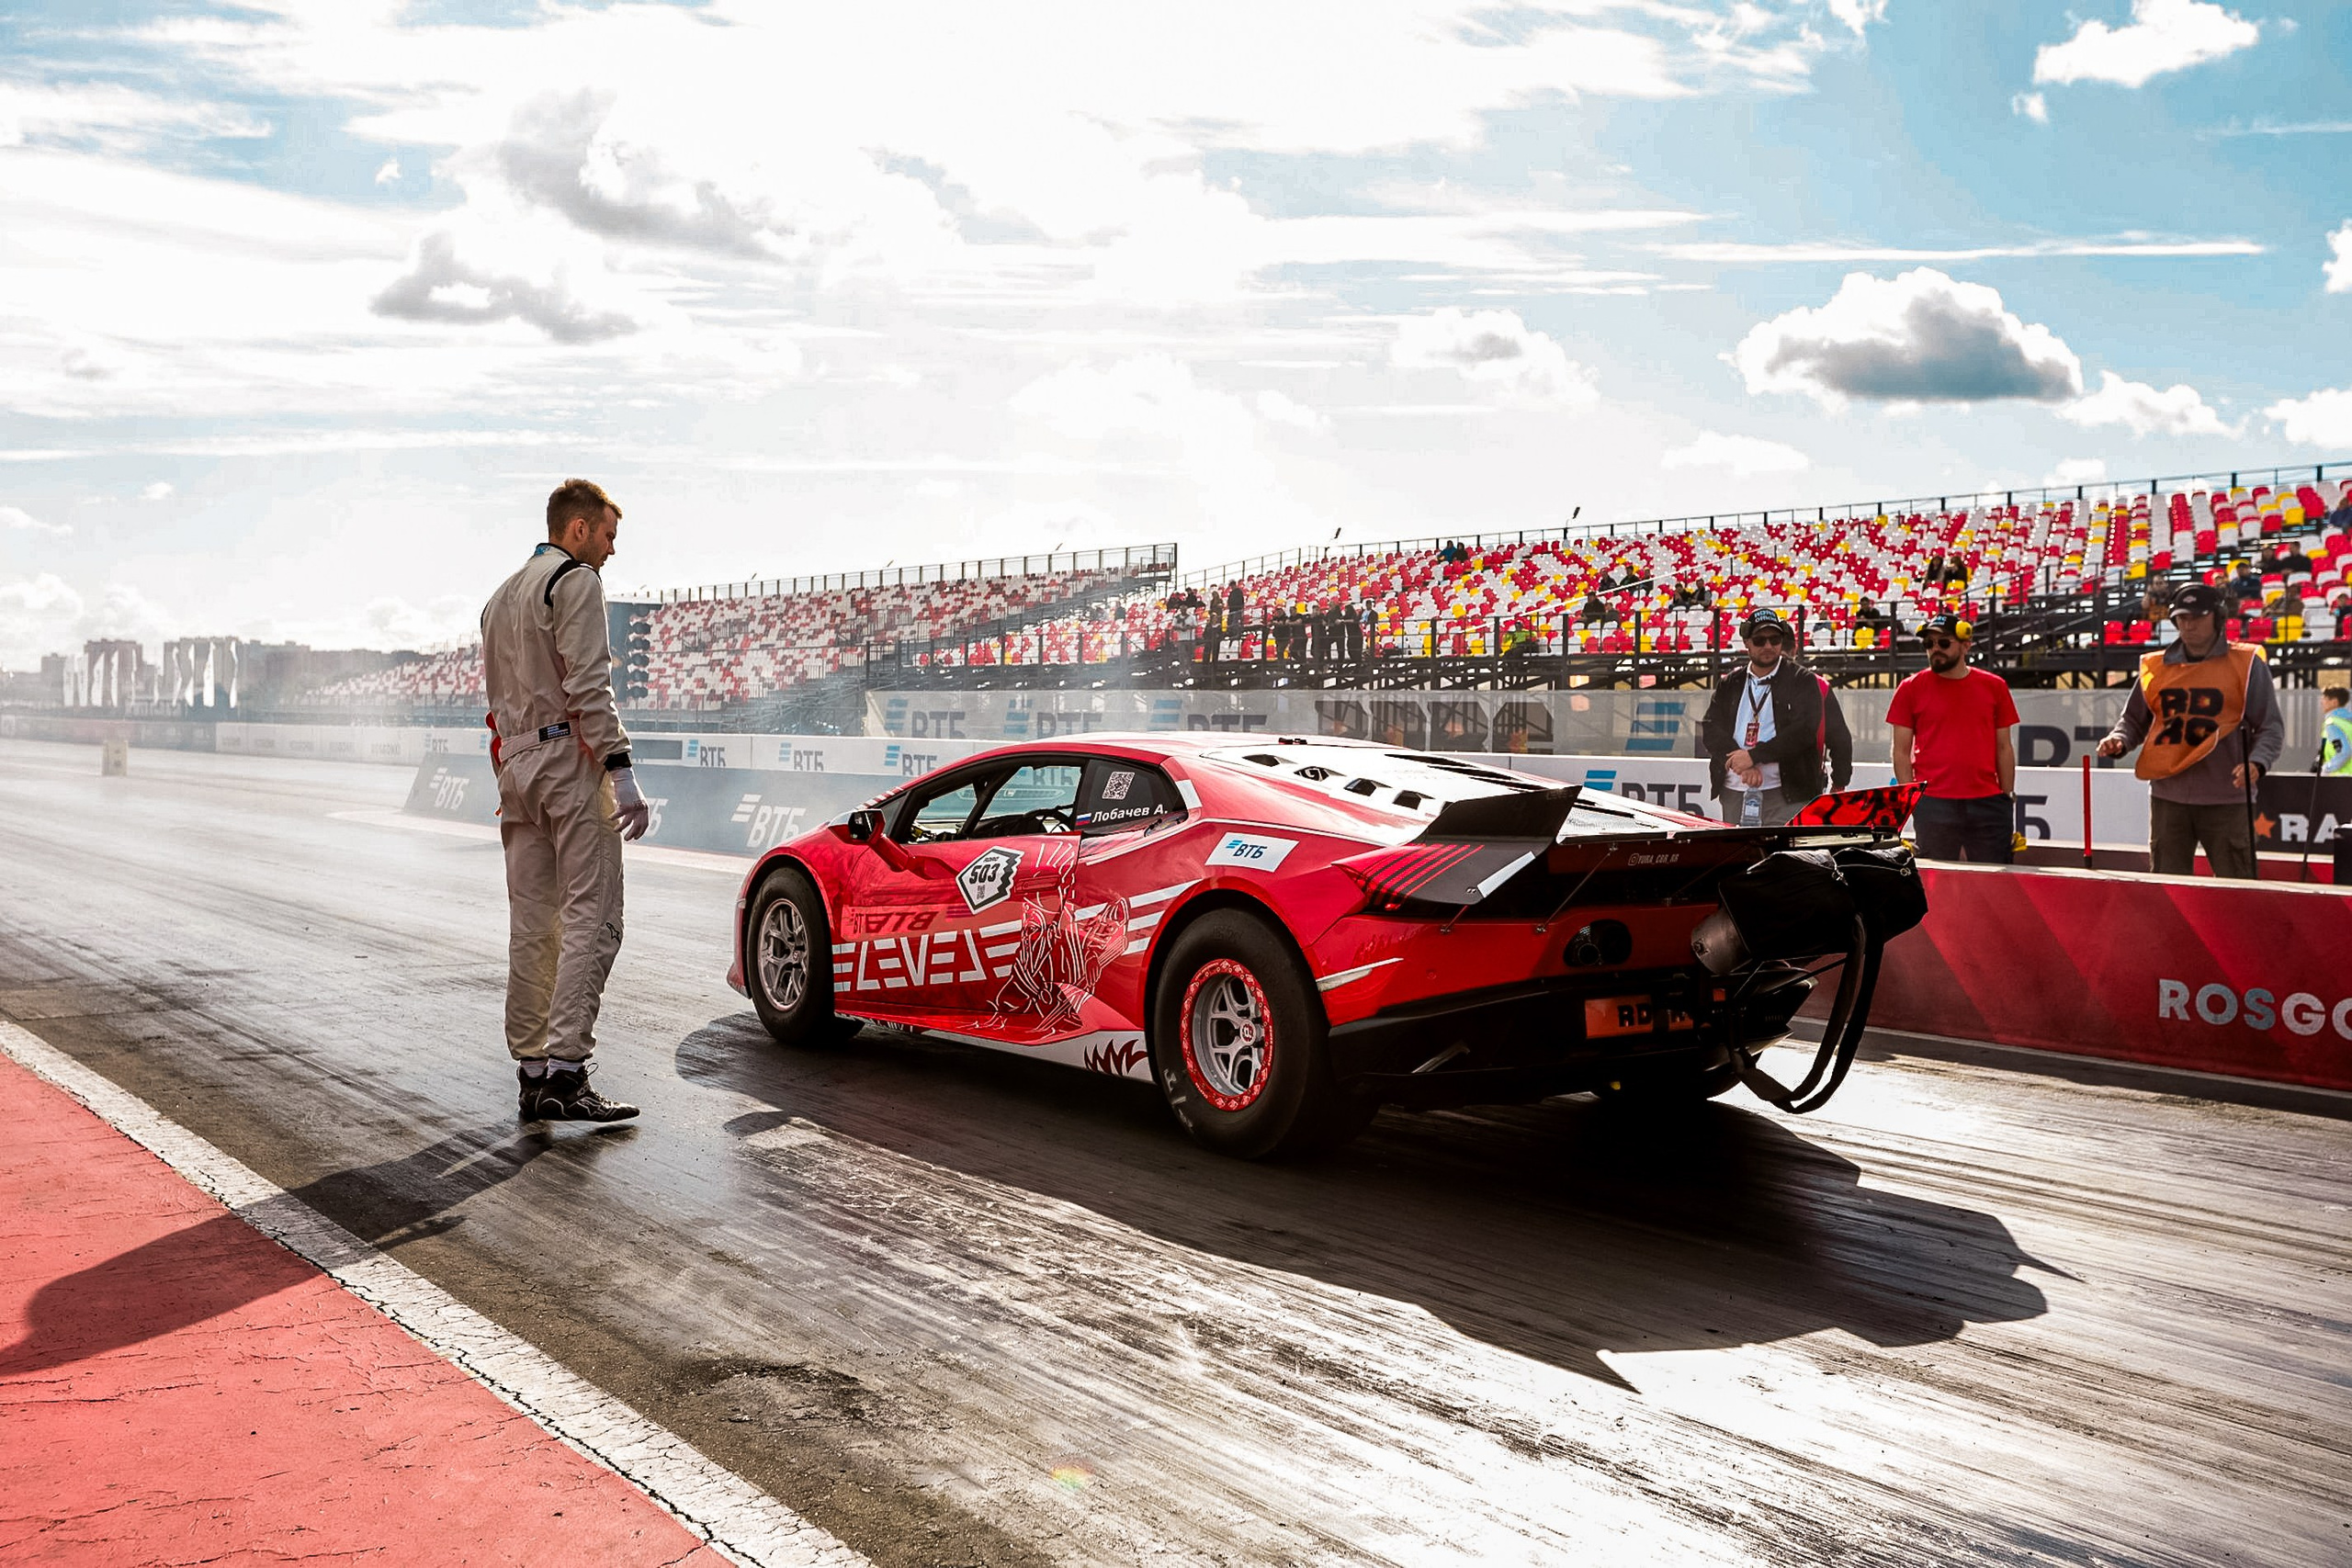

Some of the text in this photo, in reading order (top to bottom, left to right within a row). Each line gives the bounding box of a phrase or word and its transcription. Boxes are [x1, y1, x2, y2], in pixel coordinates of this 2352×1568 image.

[434, 776, 469, 810] ВТБ
[1091, 807, 1149, 823] Лобачев
[1233, 844, 1268, 859] ВТБ
[969, 863, 1001, 885] 503
